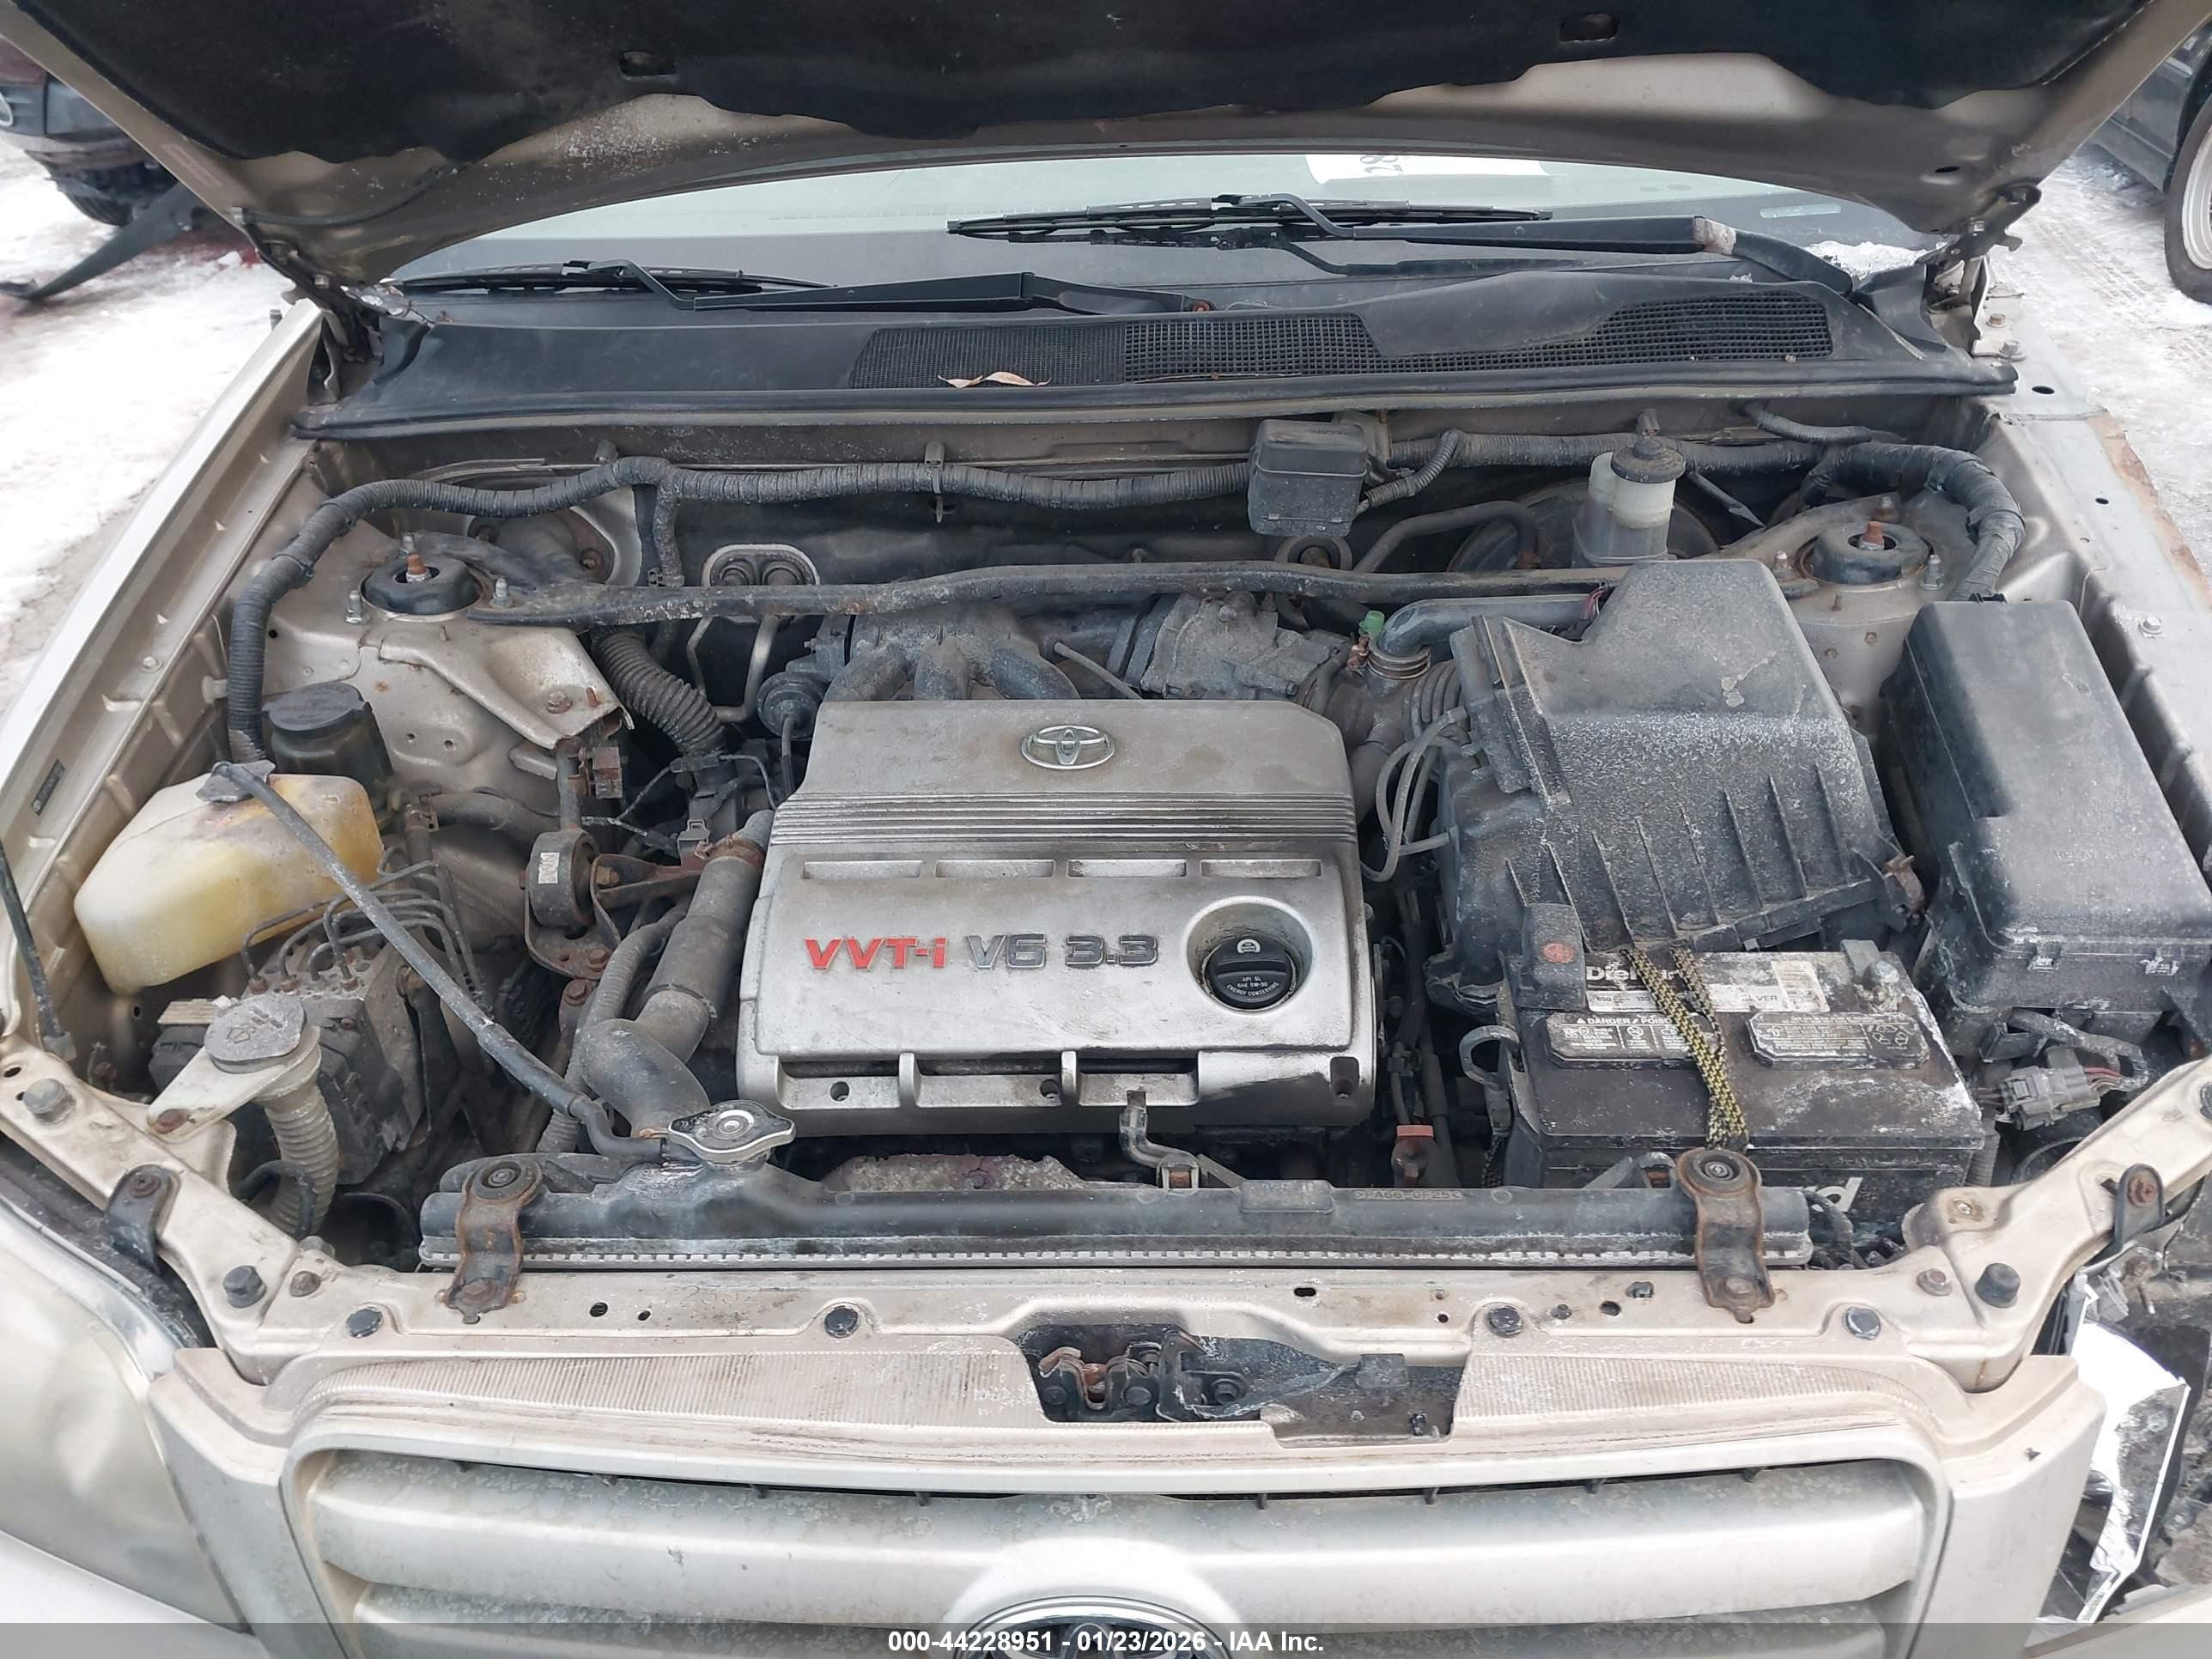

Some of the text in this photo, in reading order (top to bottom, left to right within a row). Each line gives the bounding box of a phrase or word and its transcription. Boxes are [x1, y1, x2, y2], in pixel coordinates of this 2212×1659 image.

[804, 933, 1158, 969] VVT-i V6 3.3
[1248, 981, 1279, 996] CONSERVING
